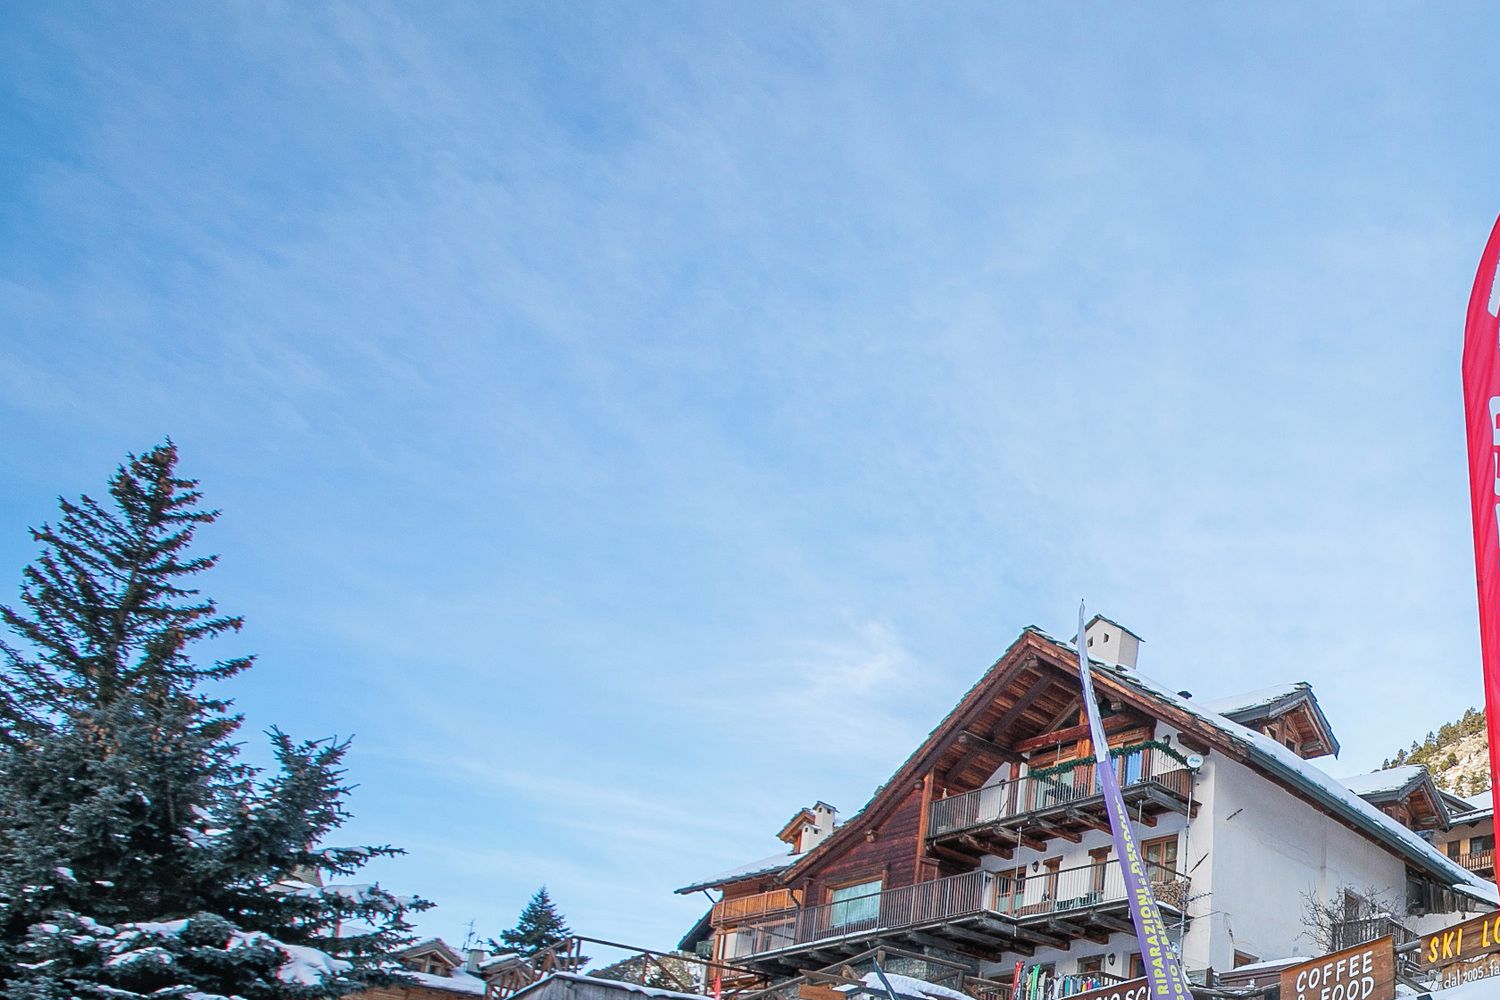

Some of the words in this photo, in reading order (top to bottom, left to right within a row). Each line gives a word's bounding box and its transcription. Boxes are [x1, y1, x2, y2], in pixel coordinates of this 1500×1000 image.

[1135, 888, 1170, 996] RIPARAZIONI
[1428, 928, 1463, 963] SKI
[1296, 950, 1374, 993] COFFEE
